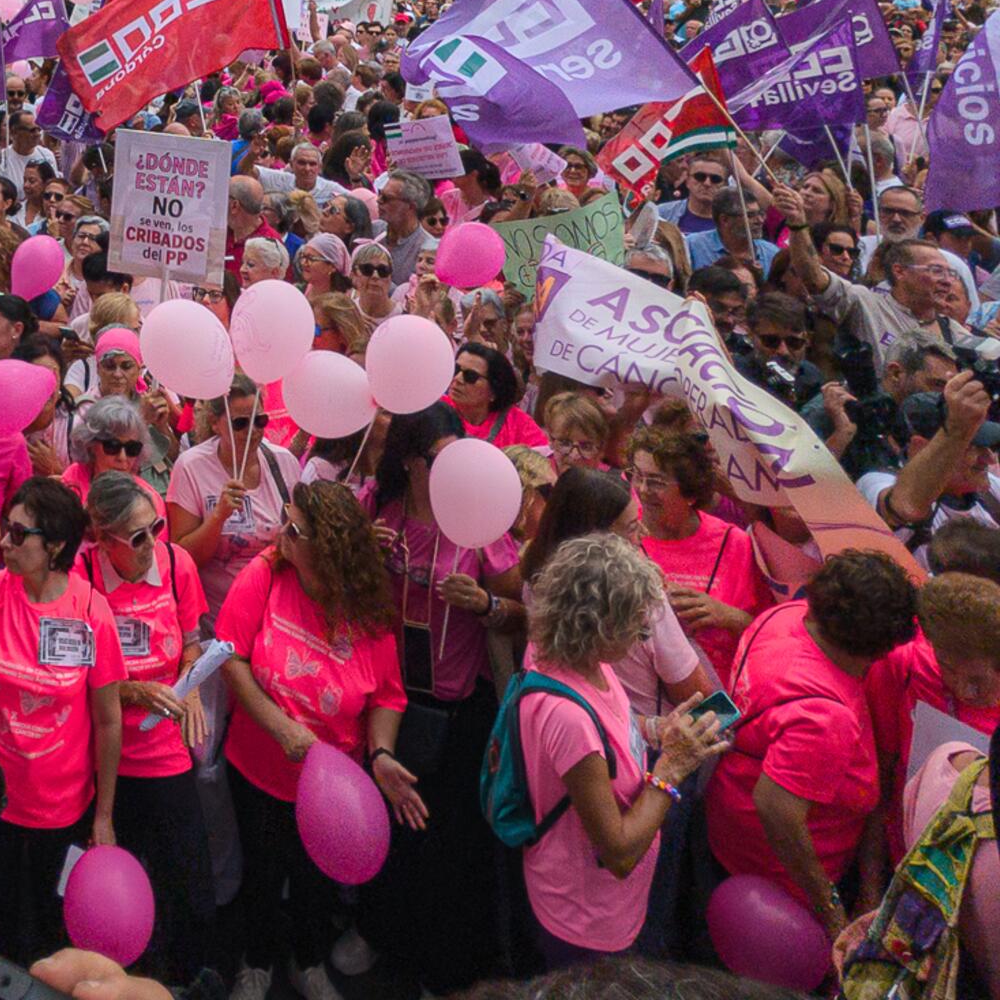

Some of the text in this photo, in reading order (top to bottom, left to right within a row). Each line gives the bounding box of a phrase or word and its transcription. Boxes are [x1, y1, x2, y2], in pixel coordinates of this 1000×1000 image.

[135, 151, 210, 179] ¿DÓNDE
[135, 171, 206, 199] ESTÁN?
[152, 196, 184, 218] NO
[140, 216, 194, 233] se ven, los
[126, 226, 206, 253] CRIBADOS
[142, 247, 189, 266] del PP
[568, 308, 600, 331] DE
[550, 339, 575, 362] DE
